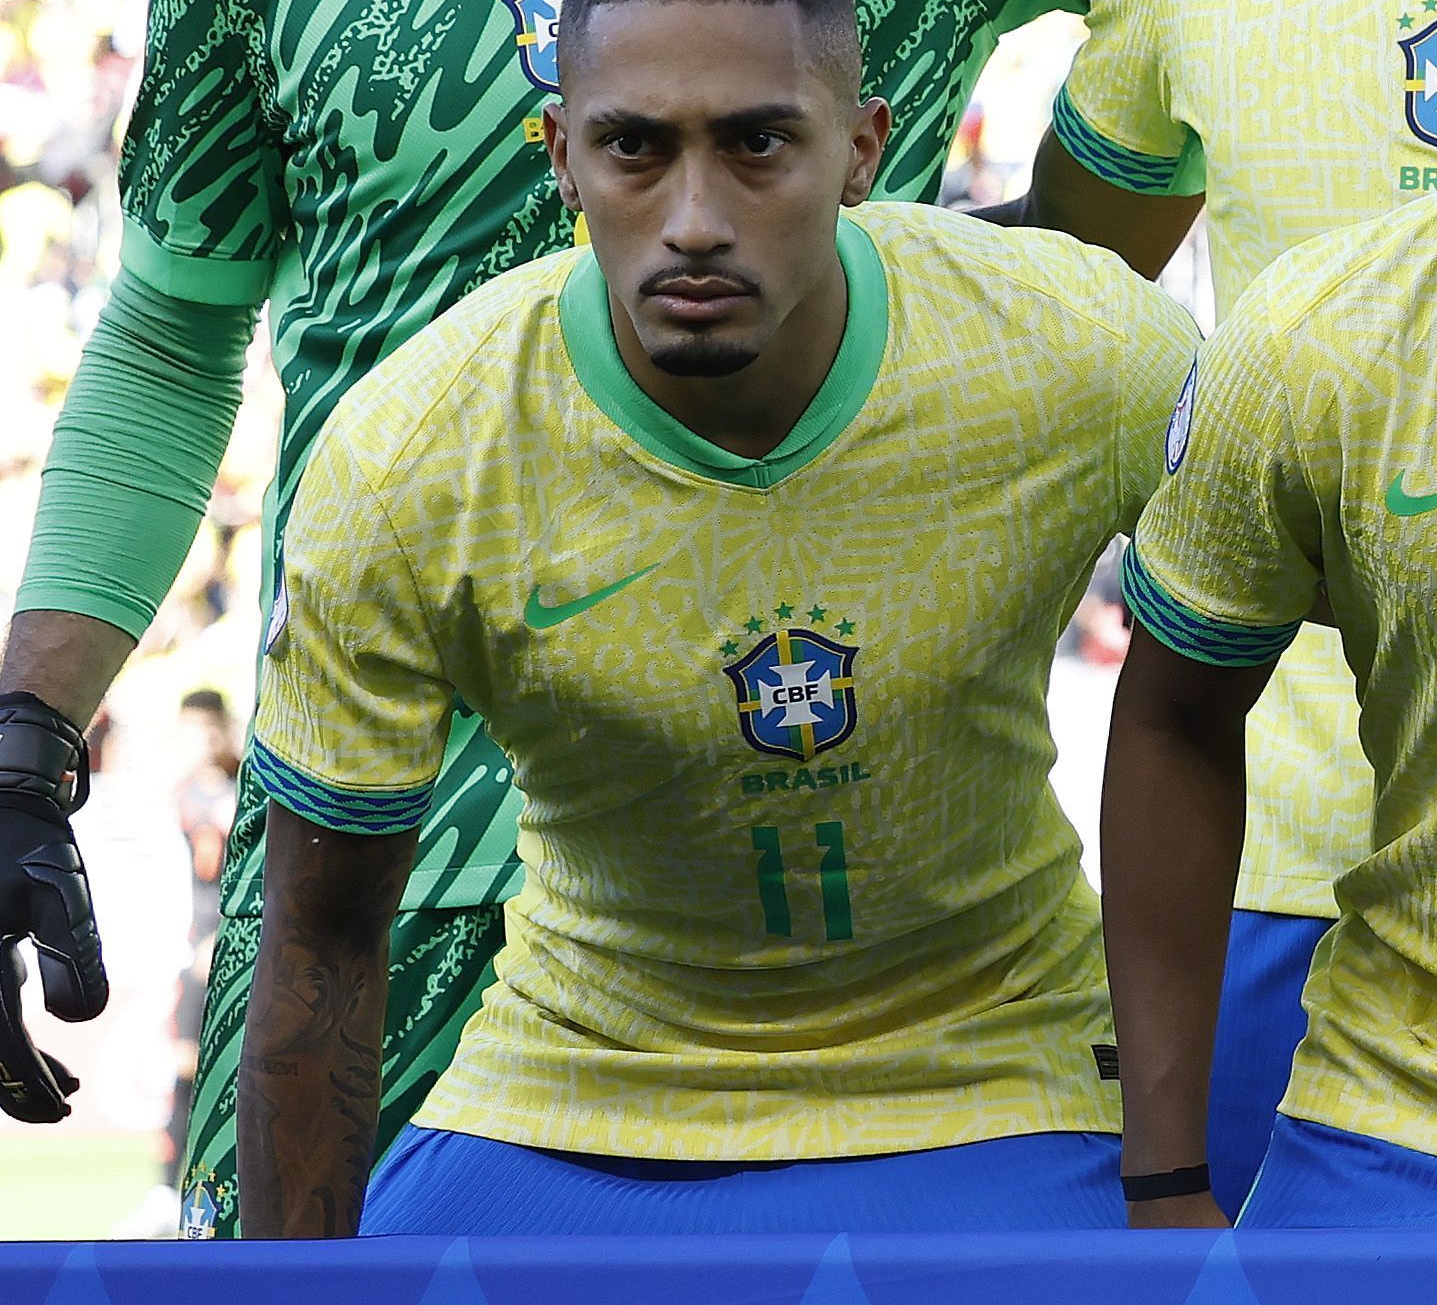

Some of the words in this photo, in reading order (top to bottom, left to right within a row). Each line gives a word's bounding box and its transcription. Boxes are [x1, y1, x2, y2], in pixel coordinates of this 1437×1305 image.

[771, 680, 820, 707] CBF
[740, 761, 871, 794] BRASIL
[751, 821, 853, 942] 11
